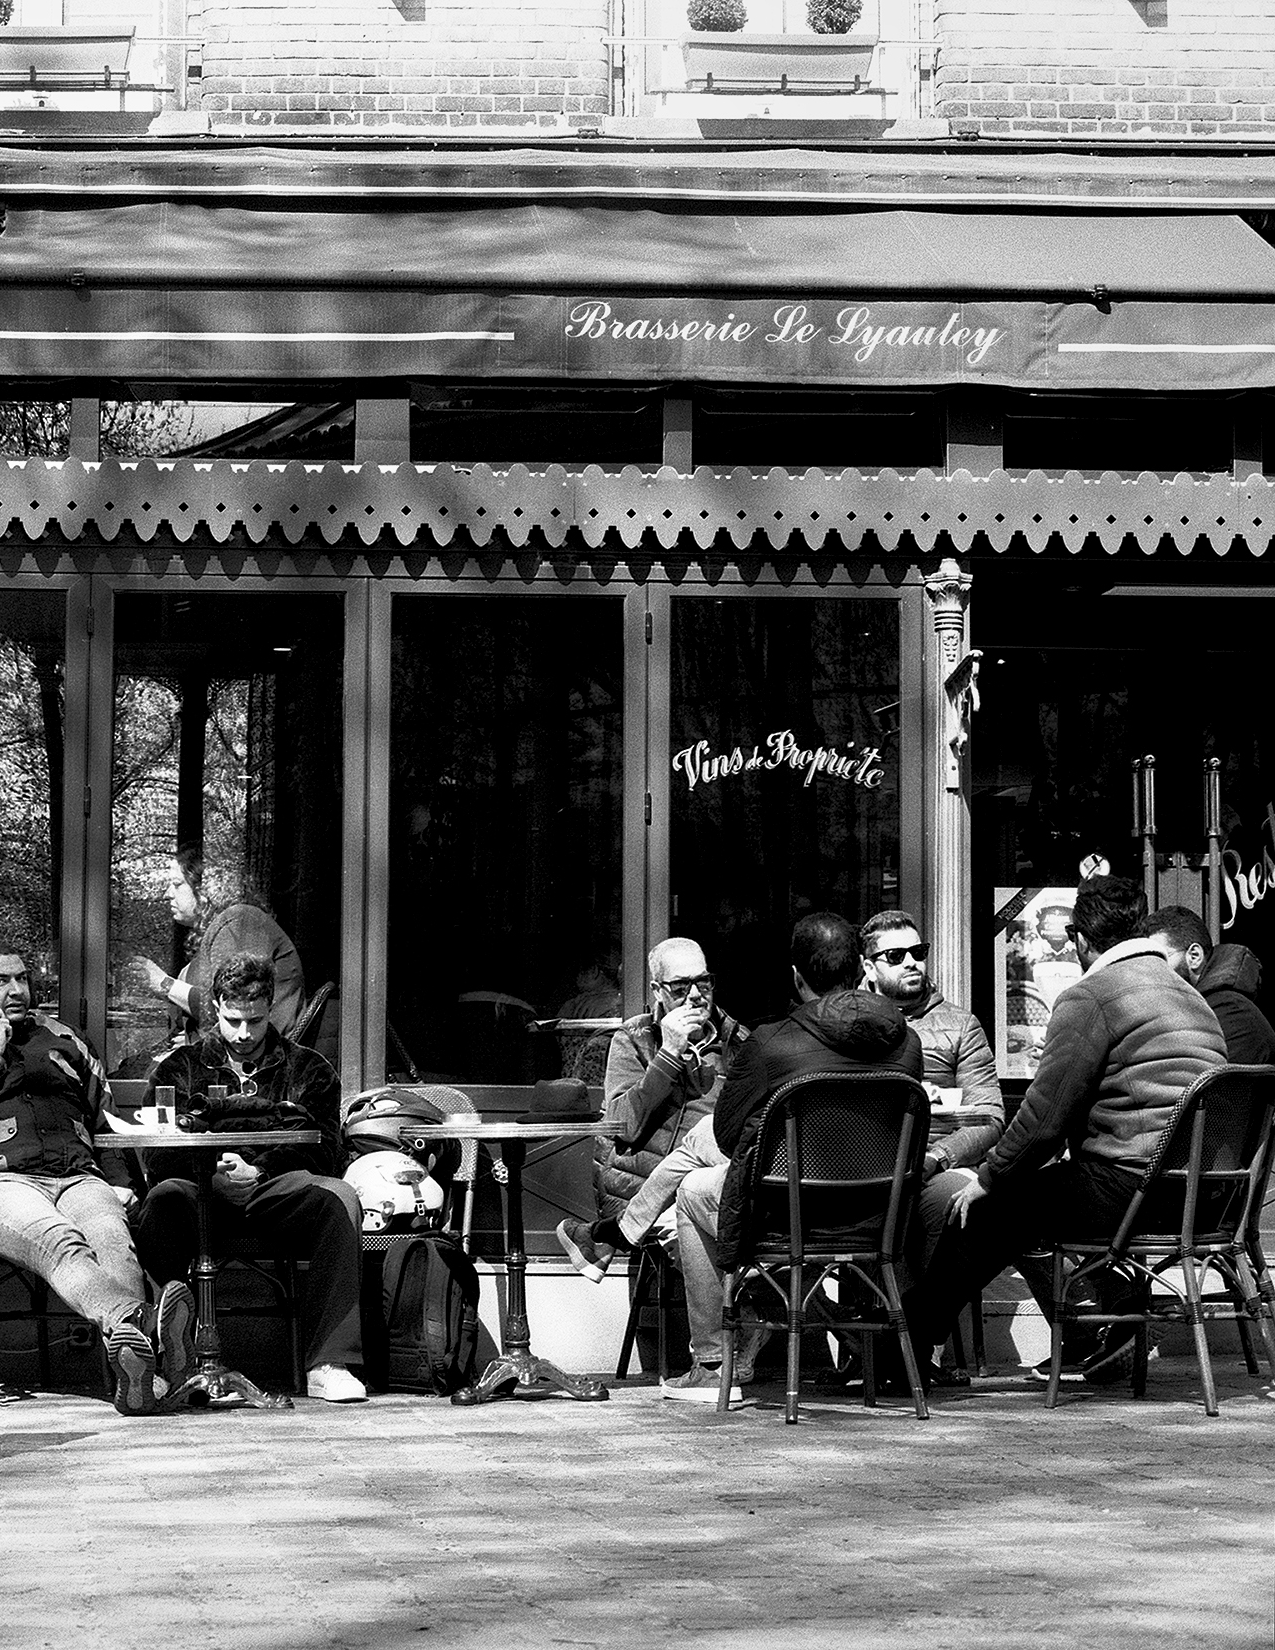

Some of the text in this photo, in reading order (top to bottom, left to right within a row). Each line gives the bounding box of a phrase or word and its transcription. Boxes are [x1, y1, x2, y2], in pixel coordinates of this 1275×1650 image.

[564, 301, 1007, 363] Brasserie Le Lyautey
[672, 740, 743, 791] Vins
[745, 746, 765, 770] de
